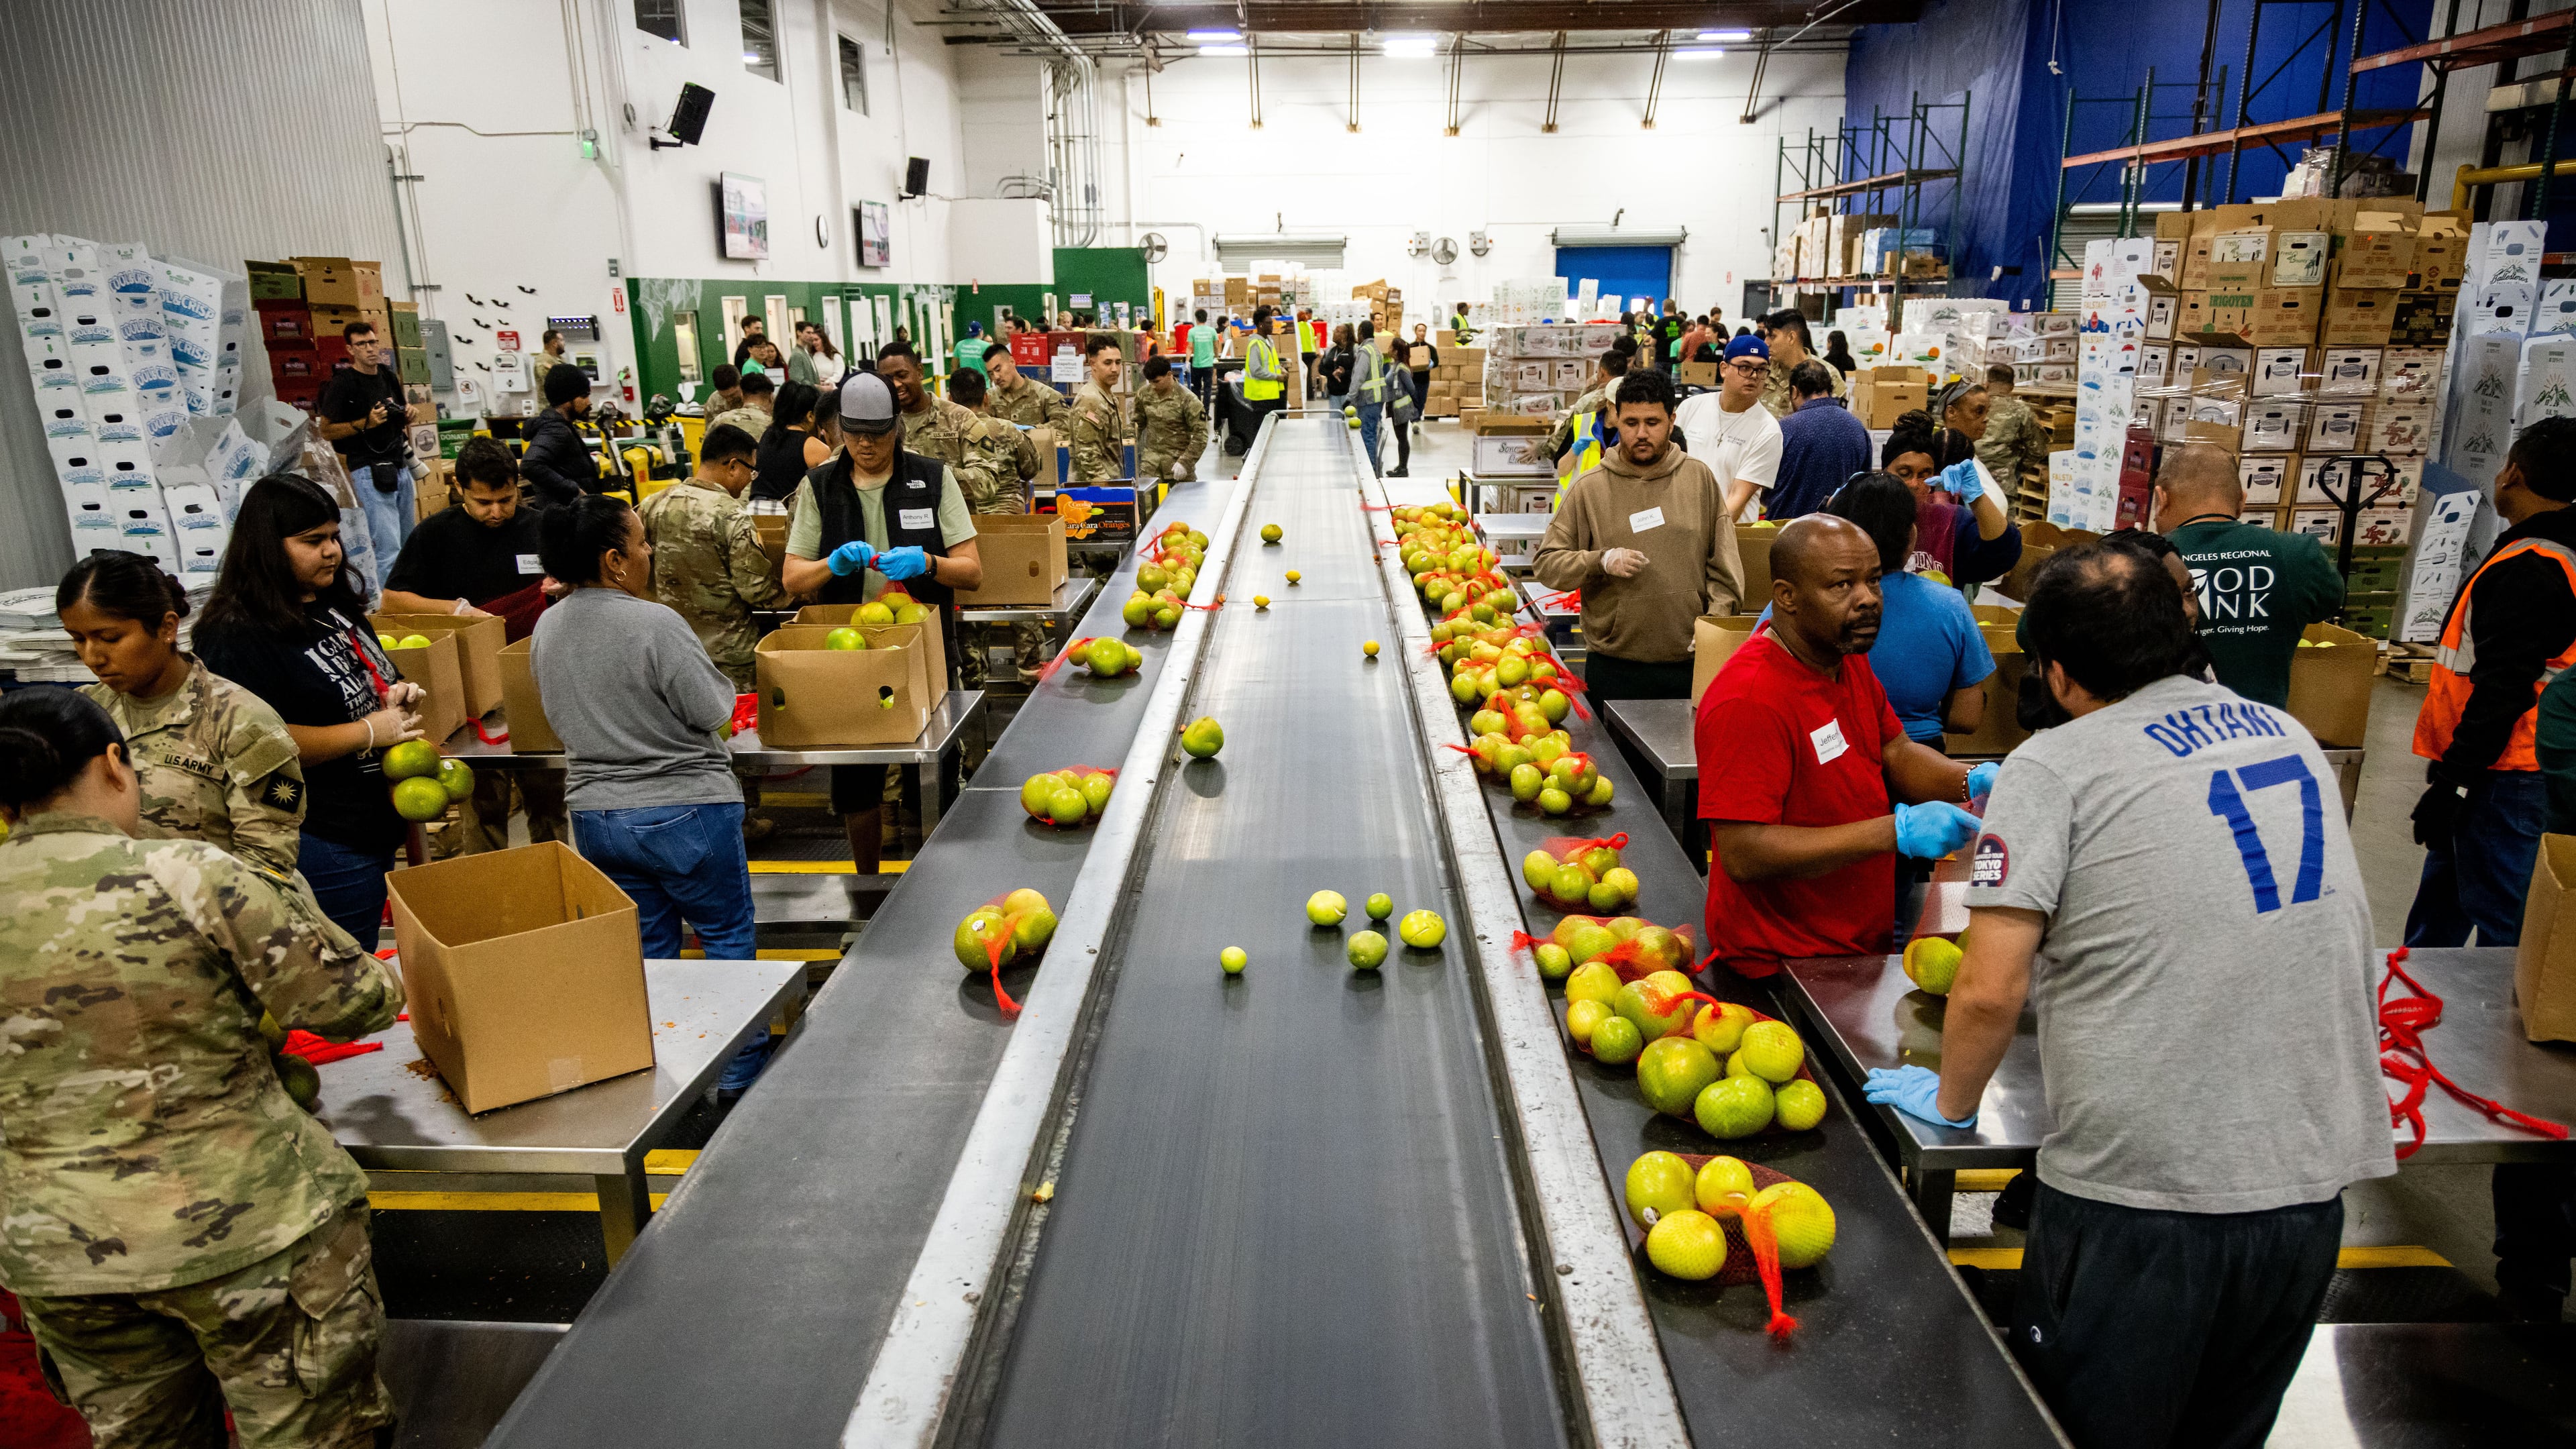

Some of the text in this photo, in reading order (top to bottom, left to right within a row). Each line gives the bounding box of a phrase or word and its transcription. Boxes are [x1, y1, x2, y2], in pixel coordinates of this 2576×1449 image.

[108, 269, 154, 292] COOL&CRISP
[2489, 272, 2528, 284] Ballesteros
[158, 288, 216, 320] OL&CRISP
[2209, 294, 2254, 308] IRIGOYEN
[69, 326, 114, 340] COOL&CRISP
[169, 335, 211, 362] &CRISP
[133, 366, 177, 390] COOL&CRISP
[2052, 474, 2072, 482] FALSTA
[1098, 521, 1130, 529] Oranges
[2182, 550, 2271, 562] NGELES REGIONAL
[2217, 625, 2245, 634] Giving
[319, 630, 354, 657] CAN
[2143, 702, 2286, 757] OHTANI
[181, 757, 215, 775] ARMY
[2208, 753, 2324, 914] 17
[1974, 859, 2002, 870] TOKYO
[1973, 869, 2002, 881] SERIES
